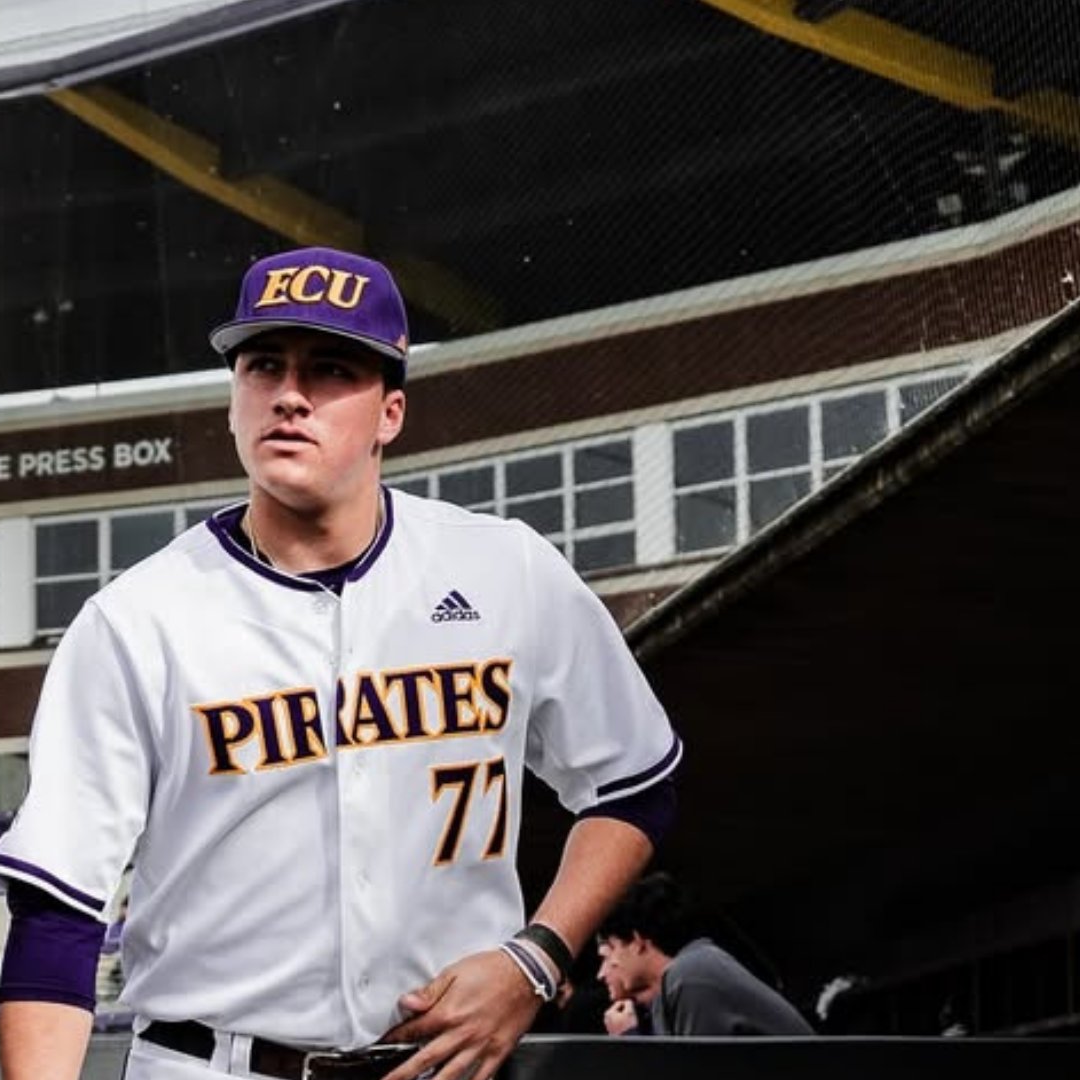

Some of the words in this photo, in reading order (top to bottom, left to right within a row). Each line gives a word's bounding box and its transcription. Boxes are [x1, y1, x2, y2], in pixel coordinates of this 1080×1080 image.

[254, 265, 370, 309] ECU
[19, 446, 105, 477] PRESS
[114, 438, 172, 468] BOX
[431, 609, 480, 623] adidas
[191, 659, 513, 775] PIRATES
[430, 757, 508, 867] 77
